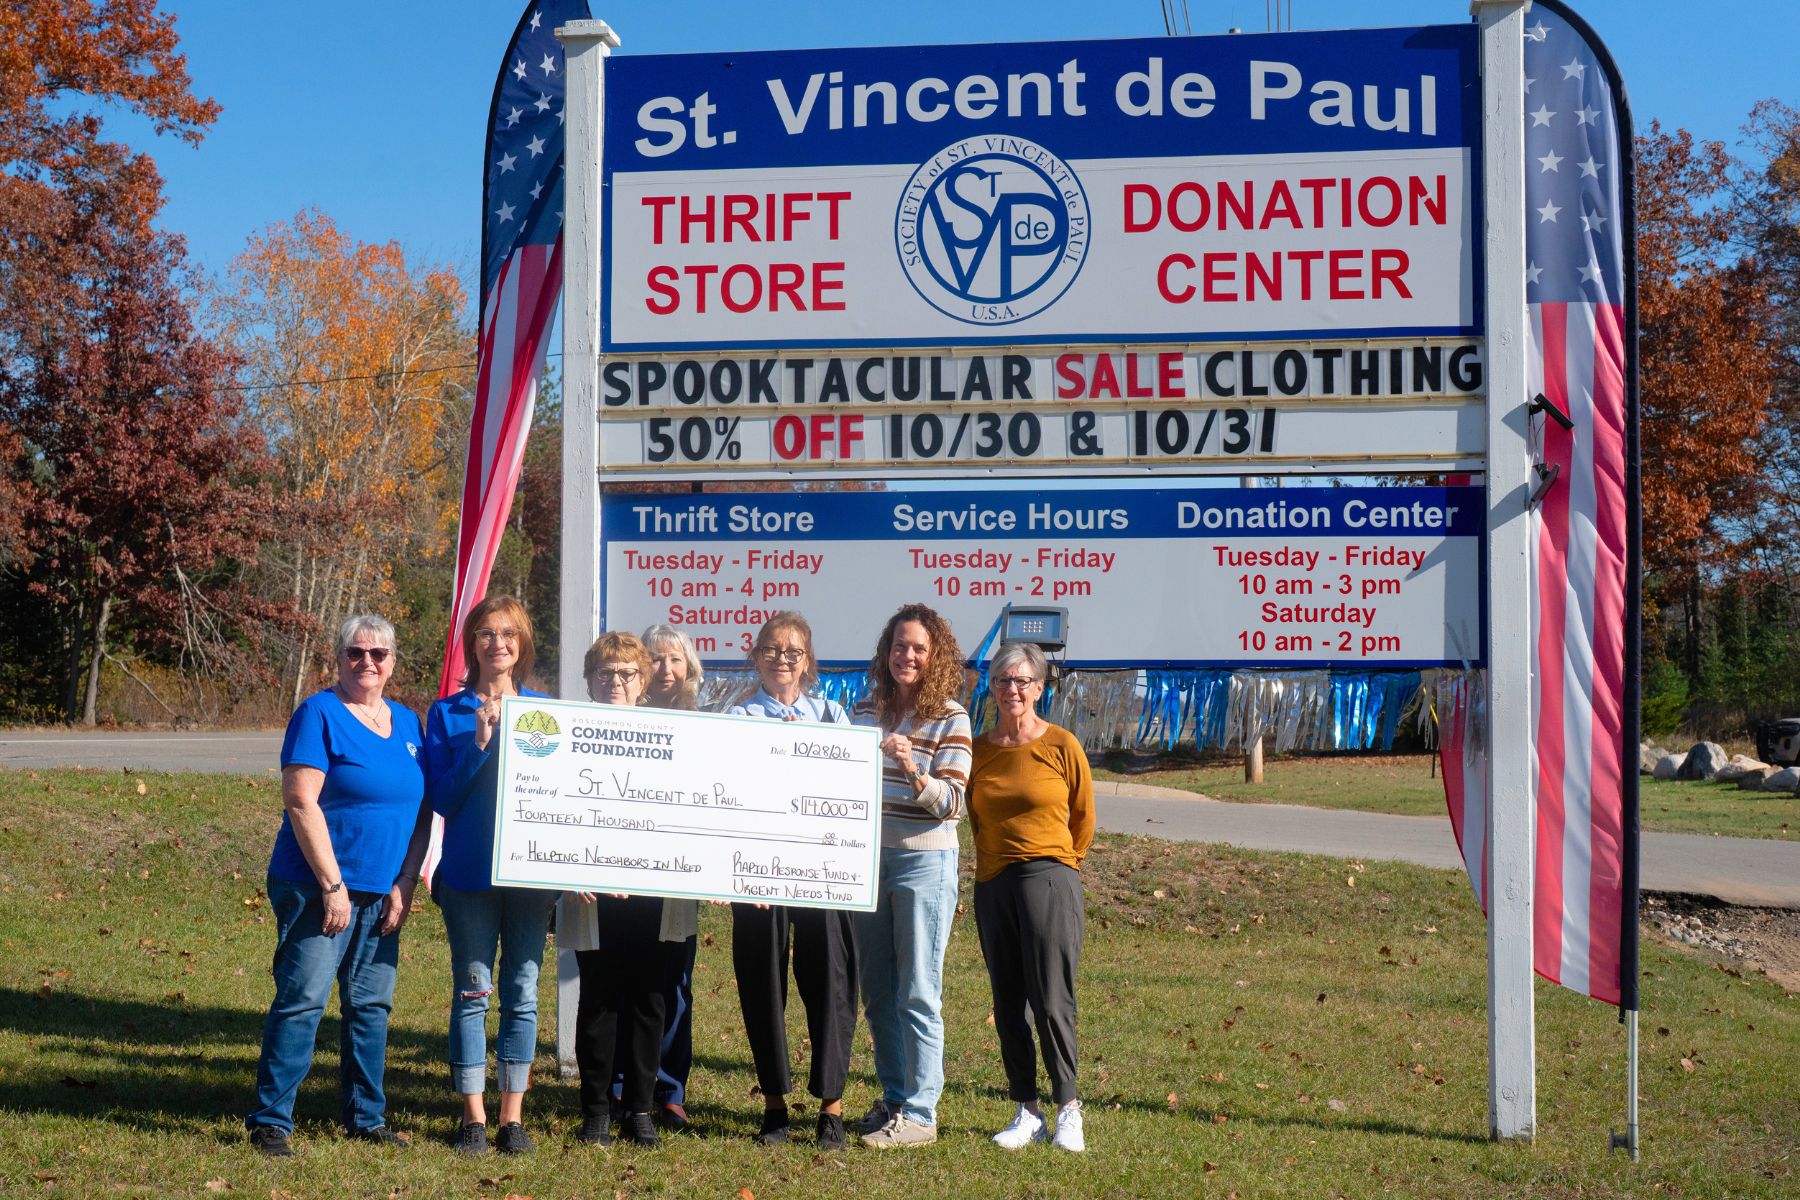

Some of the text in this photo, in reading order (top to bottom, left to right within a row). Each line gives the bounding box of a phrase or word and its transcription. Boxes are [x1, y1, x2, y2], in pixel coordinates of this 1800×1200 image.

[634, 57, 1437, 158] St. Vincent de Paul
[901, 138, 1084, 267] SOCIETY of ST. VINCENT de PAUL
[1123, 175, 1446, 233] DONATION
[641, 191, 852, 245] THRIFT
[645, 261, 846, 315] STORE
[1157, 248, 1413, 304] CENTER
[971, 305, 1020, 320] U.S.A.
[603, 345, 1482, 406] SPOOKTACULAR SALE CLOTHING
[648, 408, 1276, 462] 50% OFF 10/30 & 10/31
[632, 505, 814, 533] Thrift Store
[892, 503, 1129, 532] Service Hours
[1177, 500, 1459, 529] Donation Center
[623, 550, 724, 574] Tuesday
[748, 549, 824, 575] Friday
[909, 548, 1012, 573] Tuesday
[1037, 548, 1116, 572] Friday
[1213, 546, 1320, 571] Tuesday
[1345, 546, 1426, 571] Friday
[647, 578, 676, 597] 10
[681, 582, 719, 597] am
[740, 578, 754, 597] 4
[763, 582, 800, 603] pm
[933, 577, 960, 596] 10
[968, 581, 1006, 596] am
[1031, 576, 1044, 596] 2
[1053, 580, 1092, 601] pm
[1238, 575, 1267, 595] 10
[1275, 580, 1313, 595] am
[1338, 574, 1353, 595] 3
[1361, 579, 1401, 601] pm
[1261, 602, 1377, 628] Saturday
[690, 636, 716, 652] m
[740, 632, 753, 652] 3
[1238, 631, 1266, 651] 10
[1275, 636, 1313, 652] am
[1338, 631, 1352, 651] 2
[1361, 636, 1401, 657] pm
[571, 726, 675, 746] COMMUNITY
[571, 741, 674, 760] FOUNDATION
[516, 772, 540, 783] Pay to
[515, 785, 559, 797] the order of
[511, 853, 524, 861] For
[840, 839, 866, 849] Dollars
